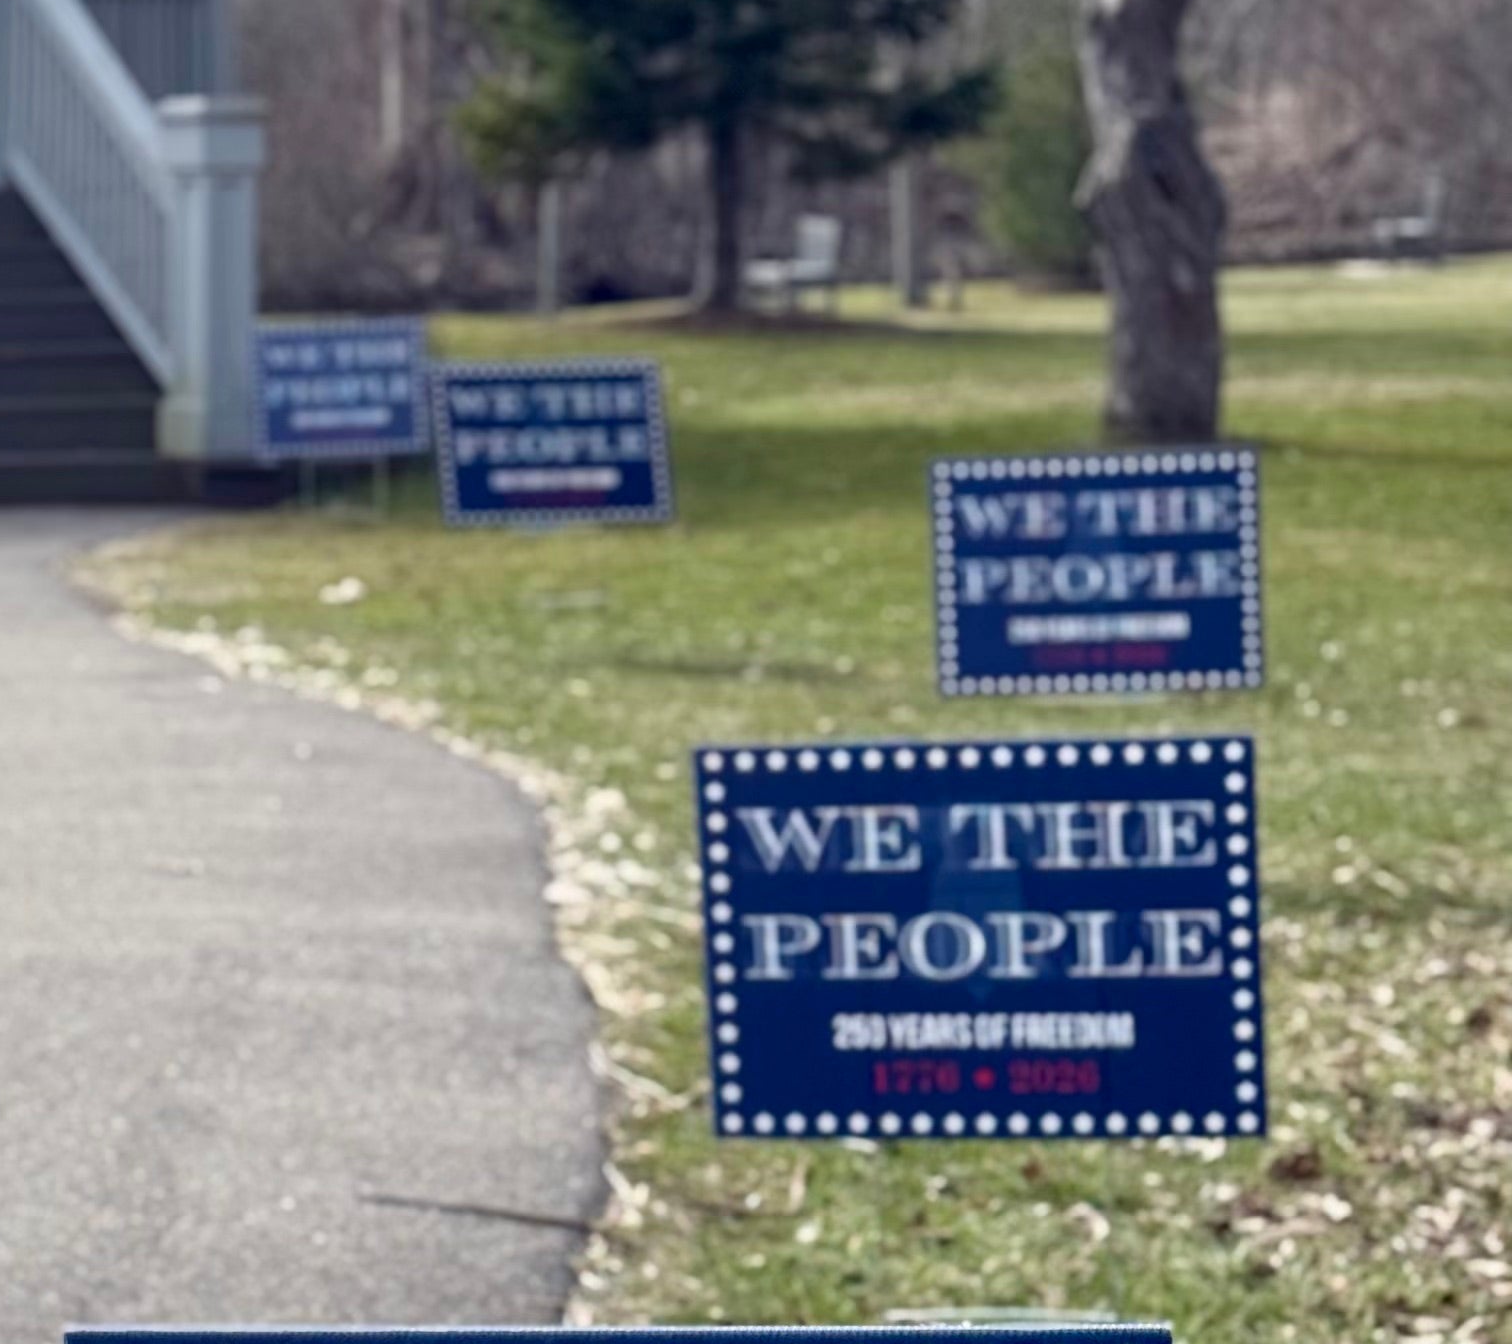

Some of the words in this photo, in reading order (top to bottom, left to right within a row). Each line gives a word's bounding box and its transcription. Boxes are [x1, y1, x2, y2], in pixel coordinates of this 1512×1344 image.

[454, 425, 647, 464] PEOPLE
[956, 490, 1066, 540] WE
[1076, 485, 1239, 536] THE
[957, 550, 1241, 605] PEOPLE
[735, 804, 922, 873] WE
[947, 799, 1219, 870] THE
[740, 909, 1224, 982] PEOPLE
[888, 1013, 973, 1049] YEARS
[975, 1013, 1009, 1049] OF
[1011, 1011, 1136, 1049] FREEDOM
[873, 1060, 961, 1095] 1776
